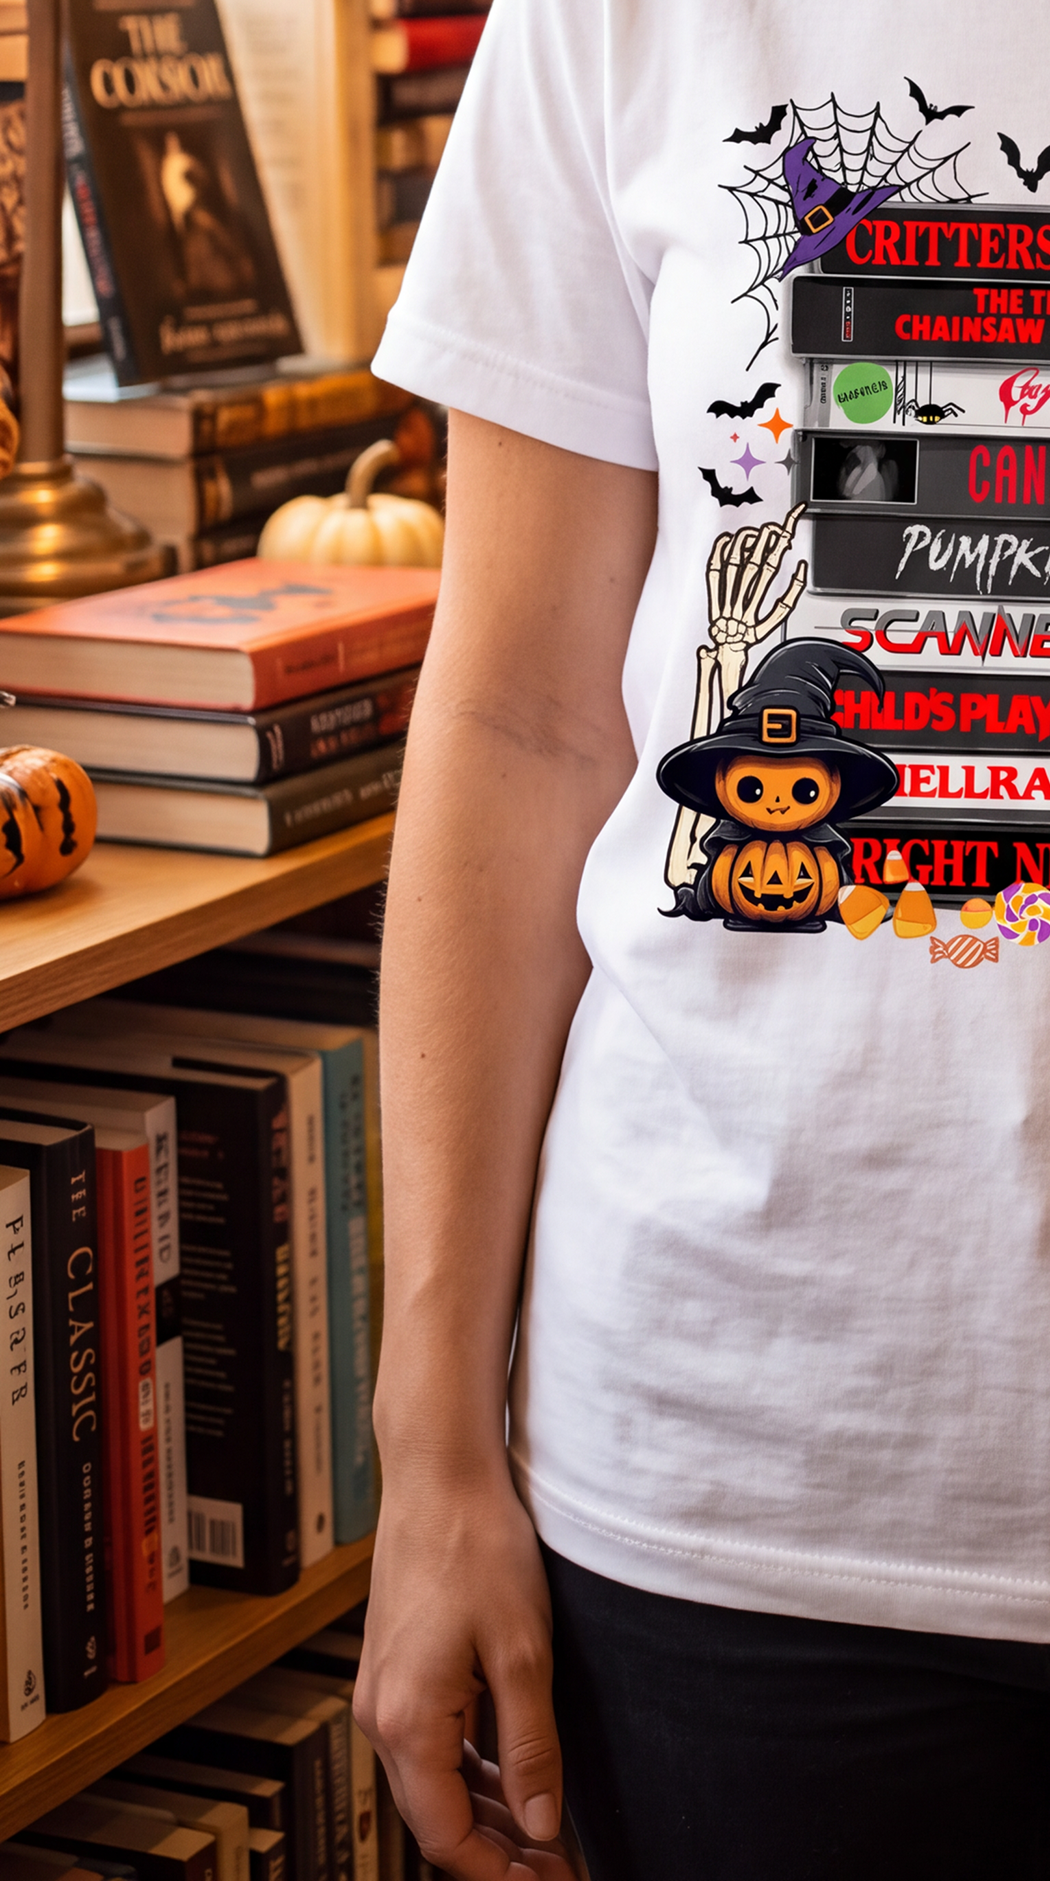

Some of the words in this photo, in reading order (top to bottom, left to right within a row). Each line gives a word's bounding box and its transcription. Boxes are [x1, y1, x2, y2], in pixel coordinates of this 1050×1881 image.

[973, 287, 1024, 315] THE
[895, 313, 1046, 345] CHAINSAW
[66, 1245, 98, 1444] CLASSIC
